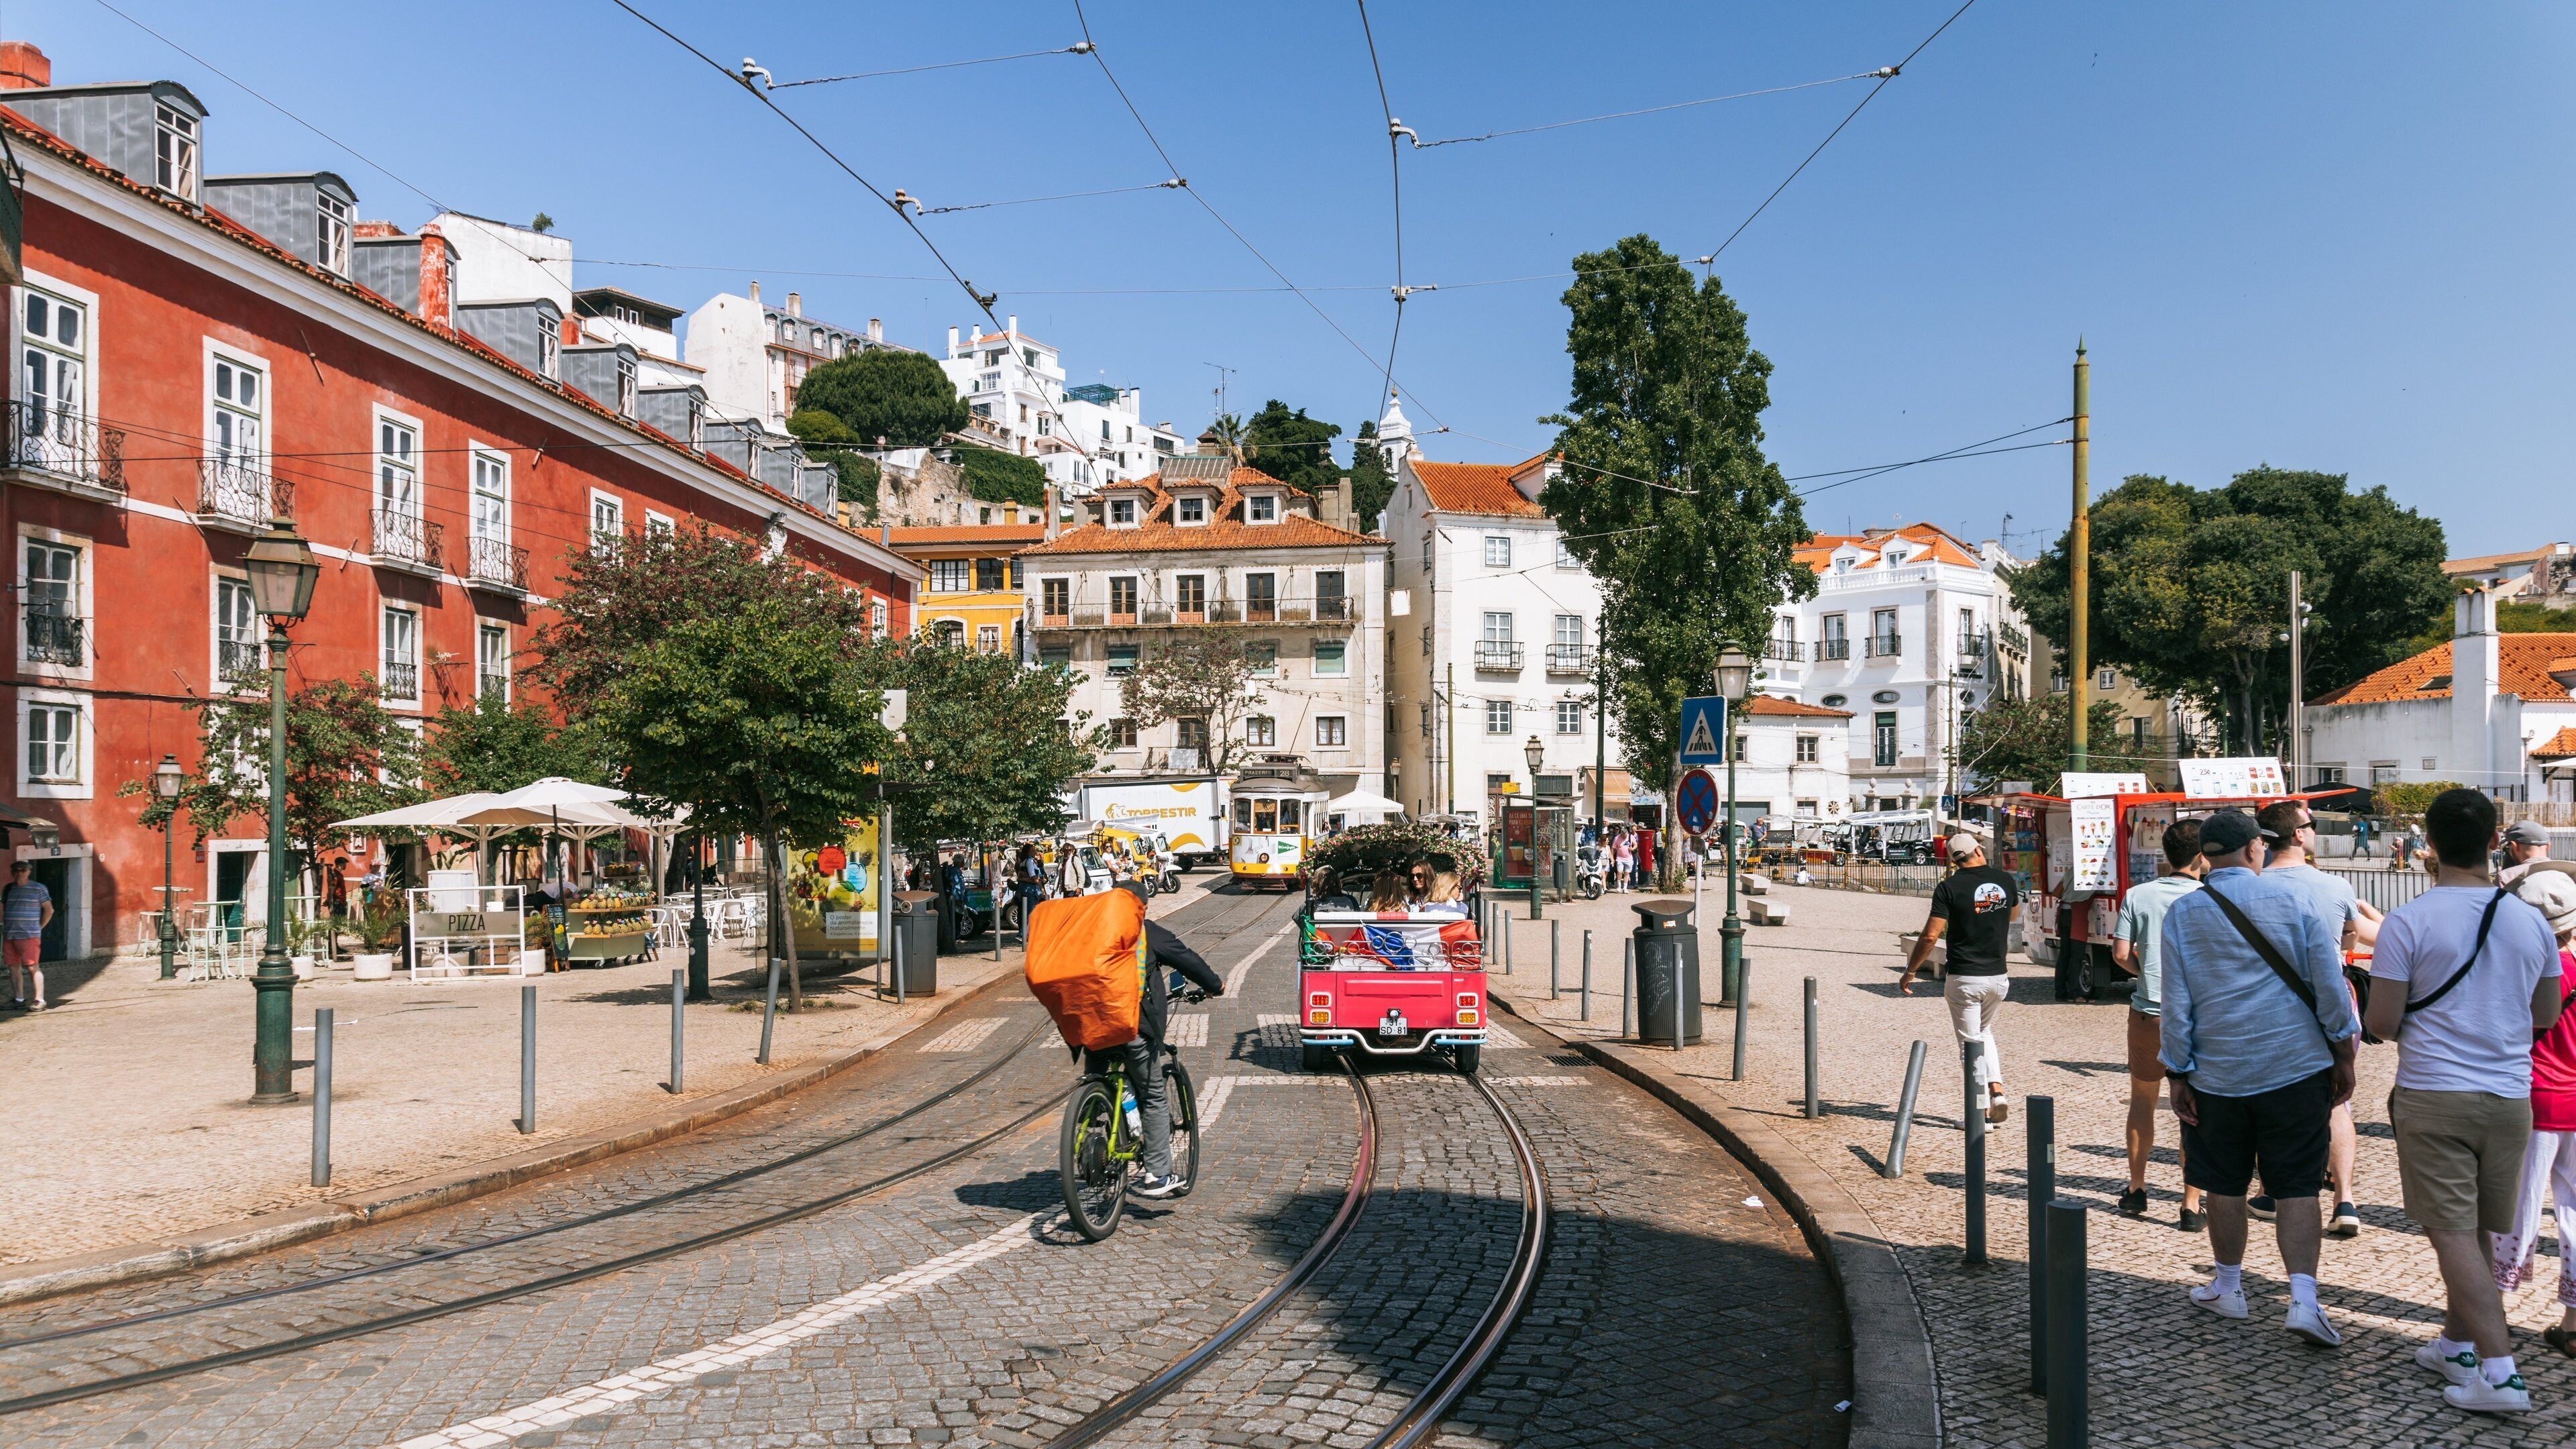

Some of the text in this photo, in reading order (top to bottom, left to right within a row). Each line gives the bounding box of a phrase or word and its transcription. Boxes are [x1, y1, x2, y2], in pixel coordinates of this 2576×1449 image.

[1127, 807, 1197, 818] TORRESTIR
[449, 914, 486, 931] PIZZA
[1389, 1018, 1398, 1026] 31
